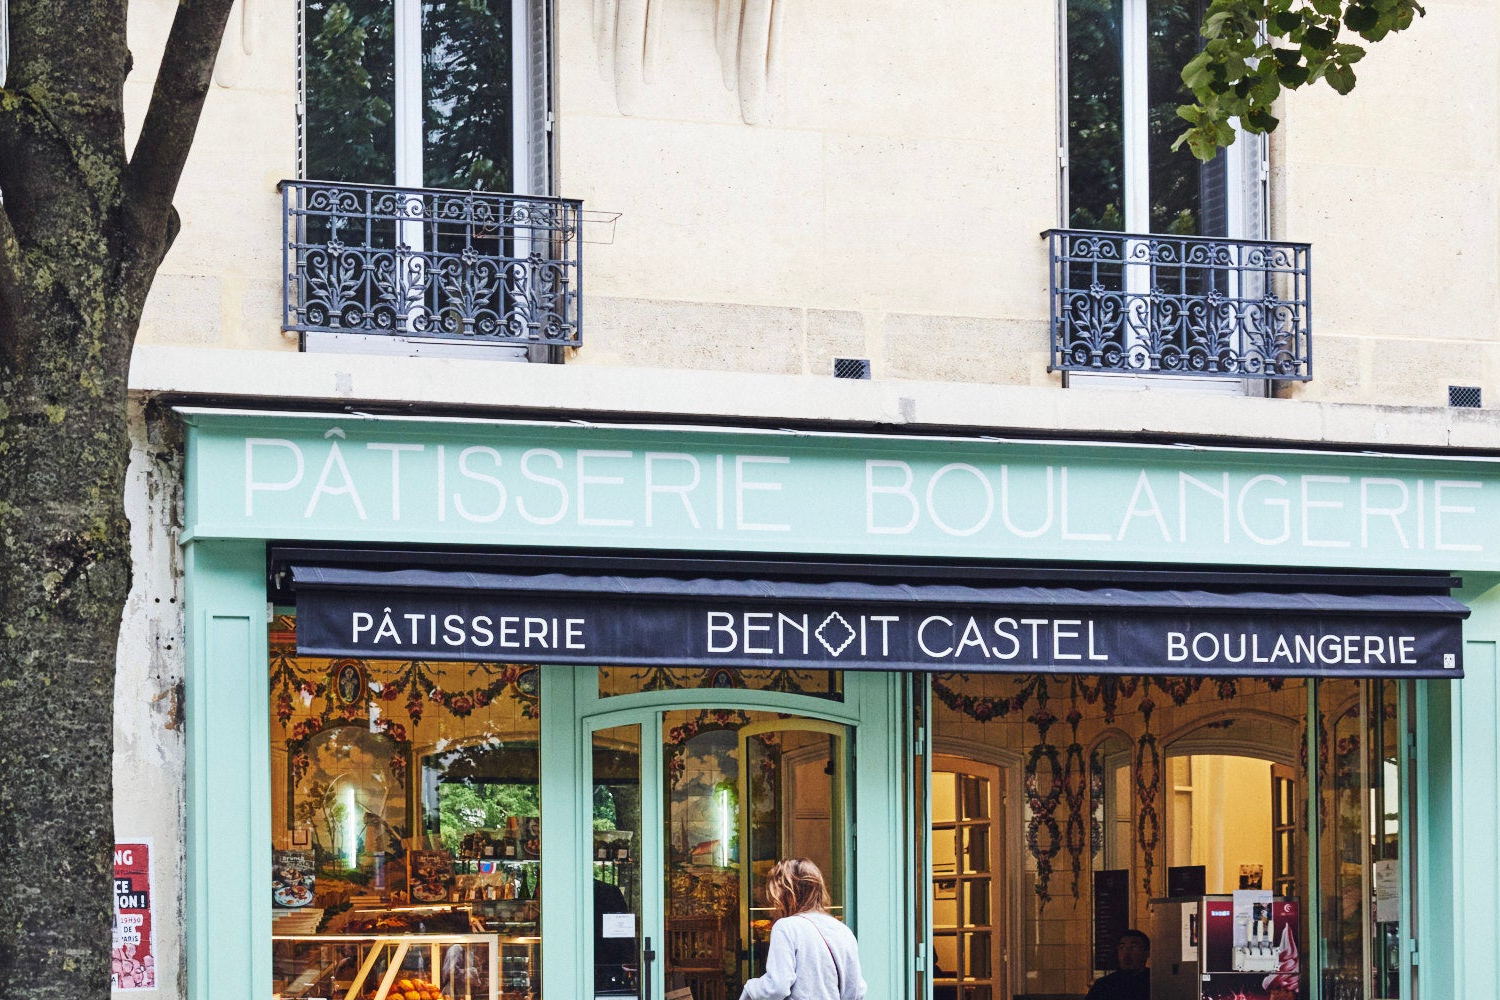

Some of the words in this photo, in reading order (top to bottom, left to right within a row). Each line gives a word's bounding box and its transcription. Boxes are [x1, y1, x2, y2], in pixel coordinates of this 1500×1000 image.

[243, 427, 792, 532] PÂTISSERIE
[865, 459, 1483, 552] BOULANGERIE
[352, 606, 586, 649] PÂTISSERIE
[707, 611, 900, 657] BENOIT
[917, 615, 1110, 661] CASTEL
[1167, 631, 1417, 664] BOULANGERIE
[114, 850, 133, 866] NG
[114, 880, 129, 894] CE
[119, 895, 138, 909] ON
